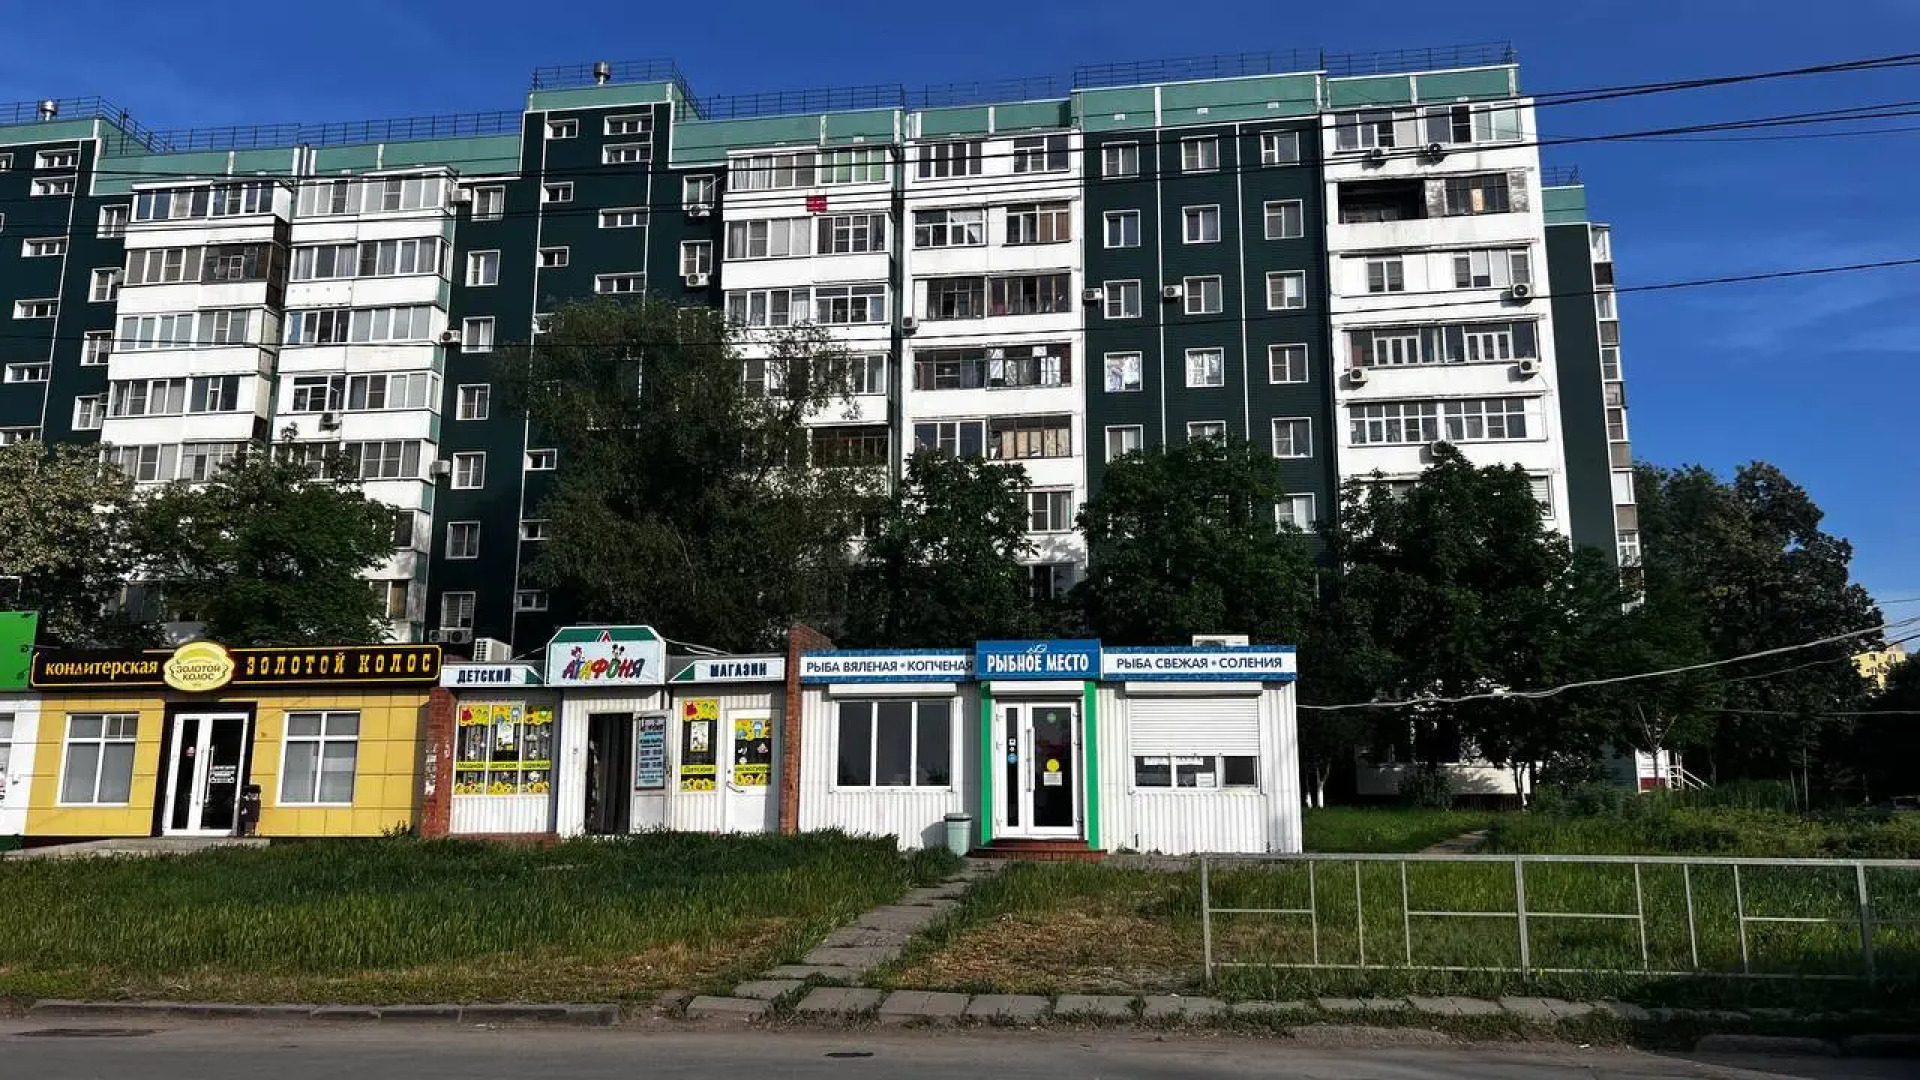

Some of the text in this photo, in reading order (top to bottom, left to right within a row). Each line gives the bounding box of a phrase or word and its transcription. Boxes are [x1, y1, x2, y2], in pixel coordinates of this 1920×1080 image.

[176, 663, 221, 673] ЗОЛОТОЙ
[246, 652, 431, 675] ЗОЛОТОЙ КОЛОС
[710, 663, 767, 677] МАГАЗИН
[806, 660, 973, 673] РЫБА ВЯЛЕНАЯ КОПЧЕНАЯ
[987, 653, 1089, 673] РЫБНОЕ МЕСТО
[1116, 657, 1282, 669] РЫБА СВЕЖАЯ СОЛЕНИЯ
[45, 661, 159, 680] кондитерская
[182, 673, 214, 681] КОЛОС
[457, 668, 511, 684] ДЕТСКИЙ
